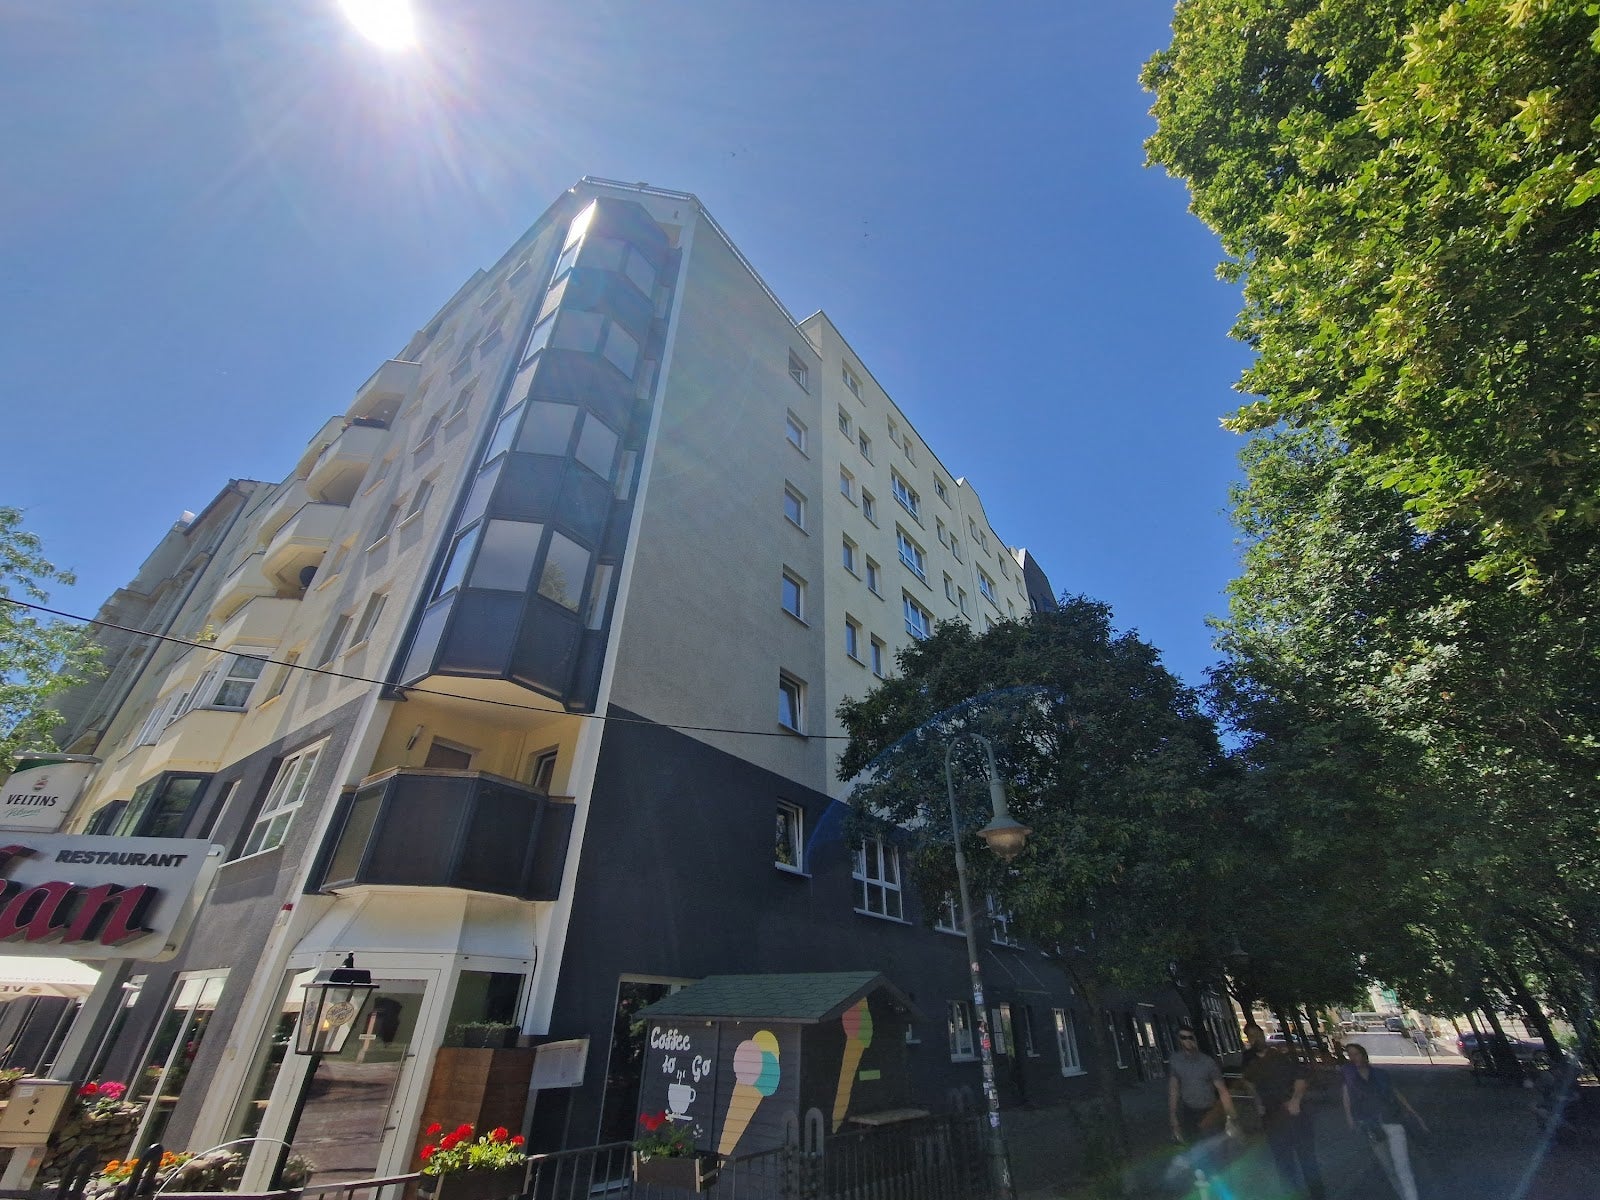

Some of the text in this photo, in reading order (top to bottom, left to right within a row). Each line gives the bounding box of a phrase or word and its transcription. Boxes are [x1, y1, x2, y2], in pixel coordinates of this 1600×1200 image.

[6, 794, 59, 807] VELTINS
[55, 849, 188, 868] RESTAURANT
[0, 879, 158, 946] an
[650, 1026, 691, 1051] Coffee
[691, 1054, 712, 1083] Go
